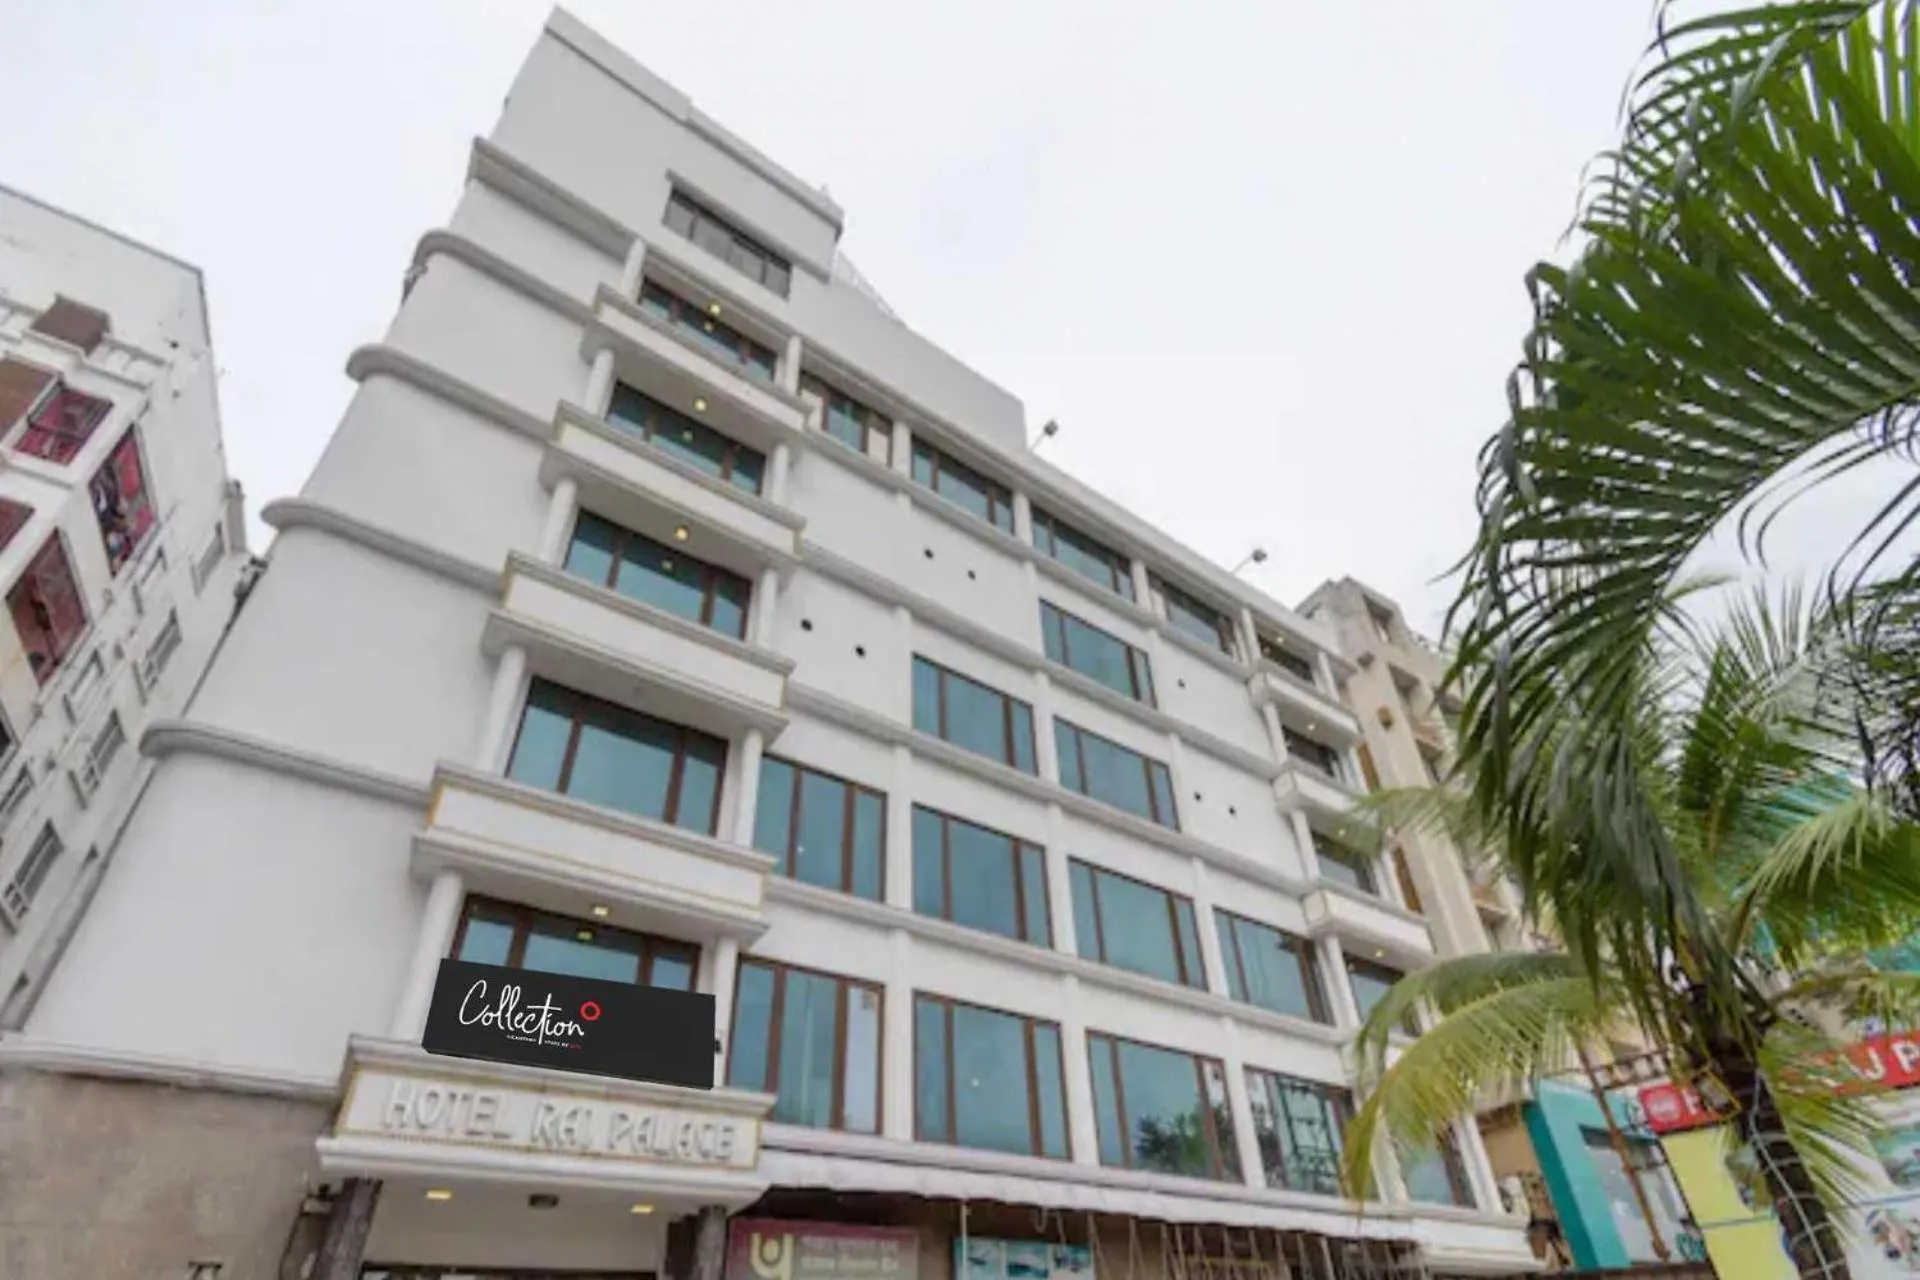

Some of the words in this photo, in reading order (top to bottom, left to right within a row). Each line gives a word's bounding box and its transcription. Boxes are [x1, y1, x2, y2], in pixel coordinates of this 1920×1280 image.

[459, 979, 584, 1045] Collection
[382, 1078, 512, 1140] HOTEL
[607, 1111, 736, 1162] PALACE
